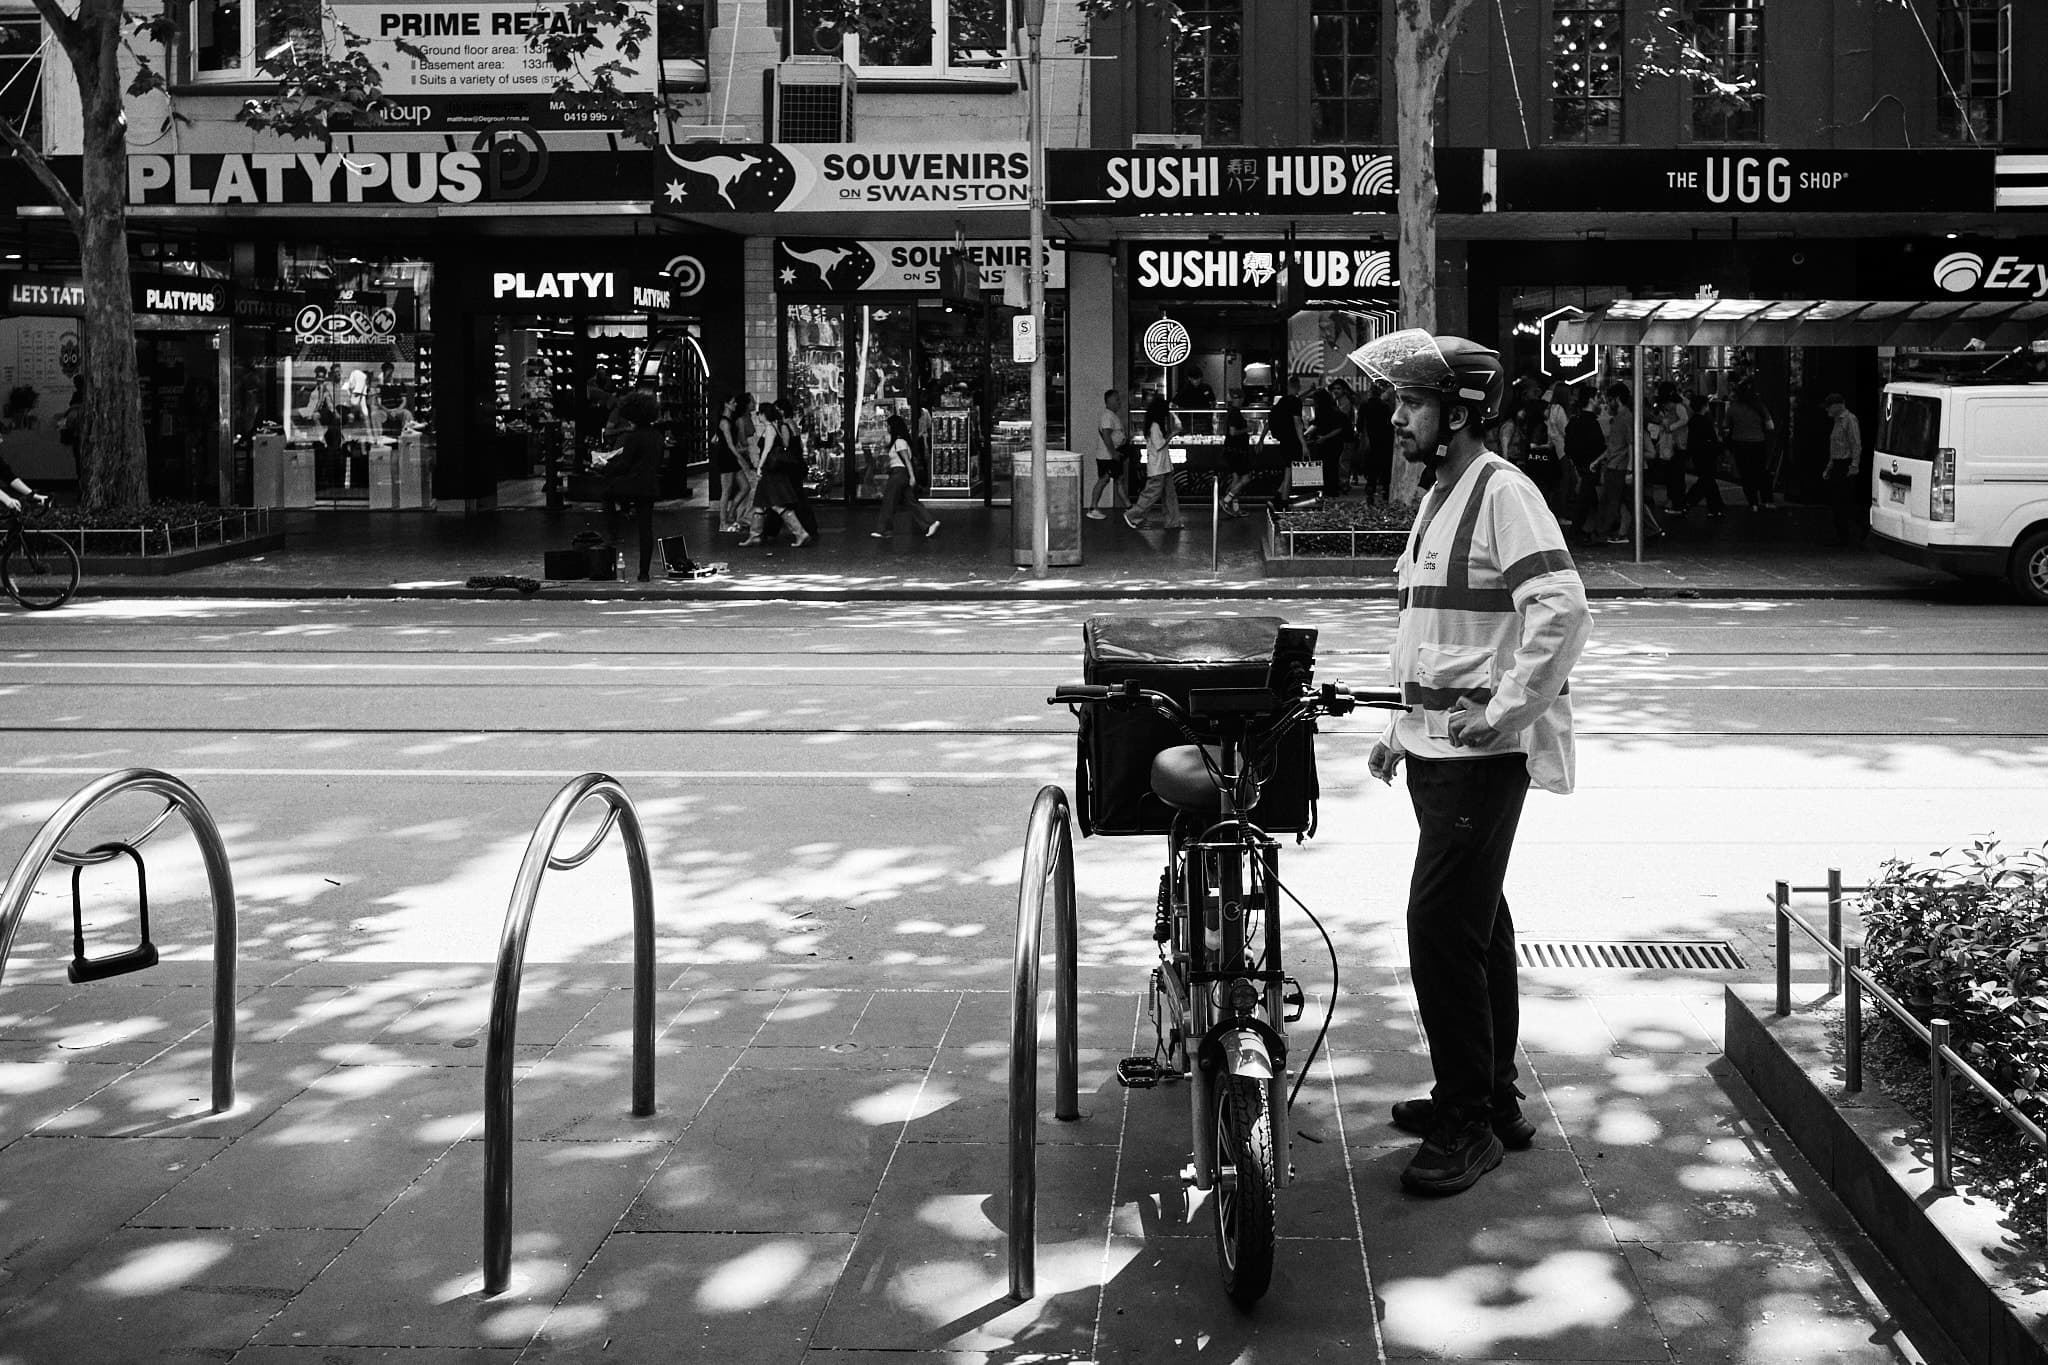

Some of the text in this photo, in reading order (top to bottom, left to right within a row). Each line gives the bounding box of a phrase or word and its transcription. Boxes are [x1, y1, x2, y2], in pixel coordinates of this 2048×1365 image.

[381, 13, 480, 39] PRIME
[419, 44, 461, 55] Ground
[464, 44, 489, 55] floor
[492, 46, 519, 55] area:
[420, 60, 475, 70] Basement
[478, 61, 504, 70] area:
[420, 74, 447, 85] Suits
[450, 76, 457, 85] a
[460, 75, 496, 87] variety
[499, 74, 510, 84] of
[513, 75, 538, 84] uses
[564, 112, 588, 122] 0419
[590, 112, 608, 122] 995
[824, 153, 1028, 180] SOUVENIRS
[1106, 156, 1346, 198] SUSHI HUB
[128, 153, 482, 203] PLATYPUS
[1667, 172, 1697, 187] THE
[1707, 157, 1790, 203] UGG
[838, 185, 1029, 202] ON SWANSTON
[1138, 251, 1237, 287] SUSHI
[13, 286, 47, 303] LETS
[147, 290, 214, 311] PLATYPUS
[633, 287, 670, 310] PLATYPUS
[296, 335, 397, 345] FOR SUMMER
